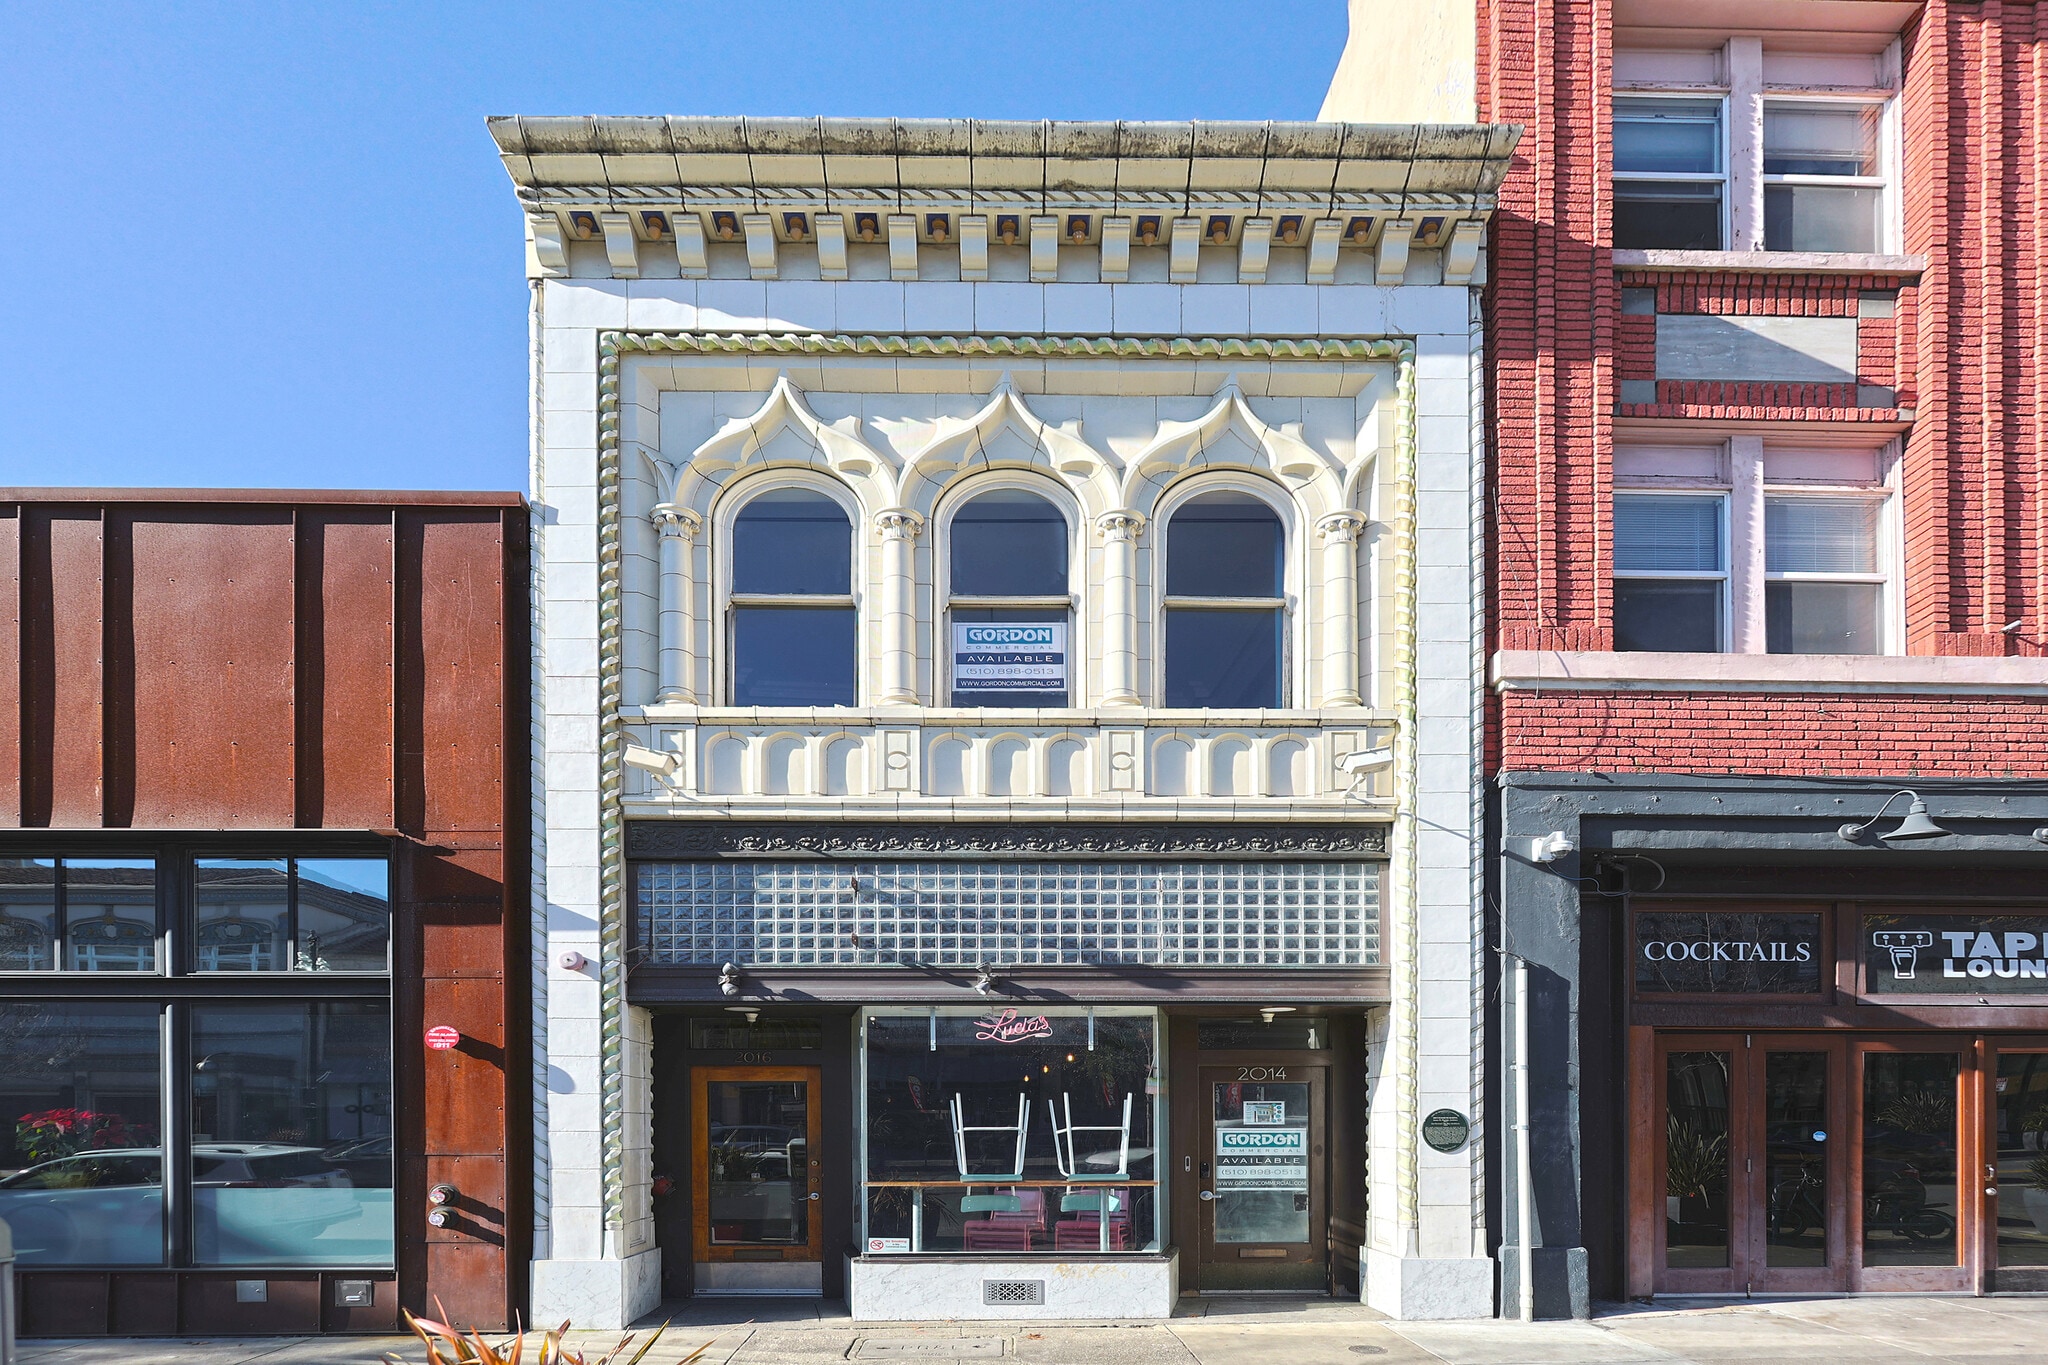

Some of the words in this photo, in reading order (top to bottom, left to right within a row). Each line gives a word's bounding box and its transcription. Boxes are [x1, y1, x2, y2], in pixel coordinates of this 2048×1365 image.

[968, 628, 1051, 643] GORDON
[966, 667, 995, 675] (510)
[997, 667, 1055, 675] 898-0513
[1643, 941, 1811, 962] COCKTAILS
[1943, 958, 2048, 978] LOUN
[735, 1052, 772, 1063] 2016
[1237, 1067, 1287, 1081] 2014
[1224, 1133, 1299, 1146] GORDON
